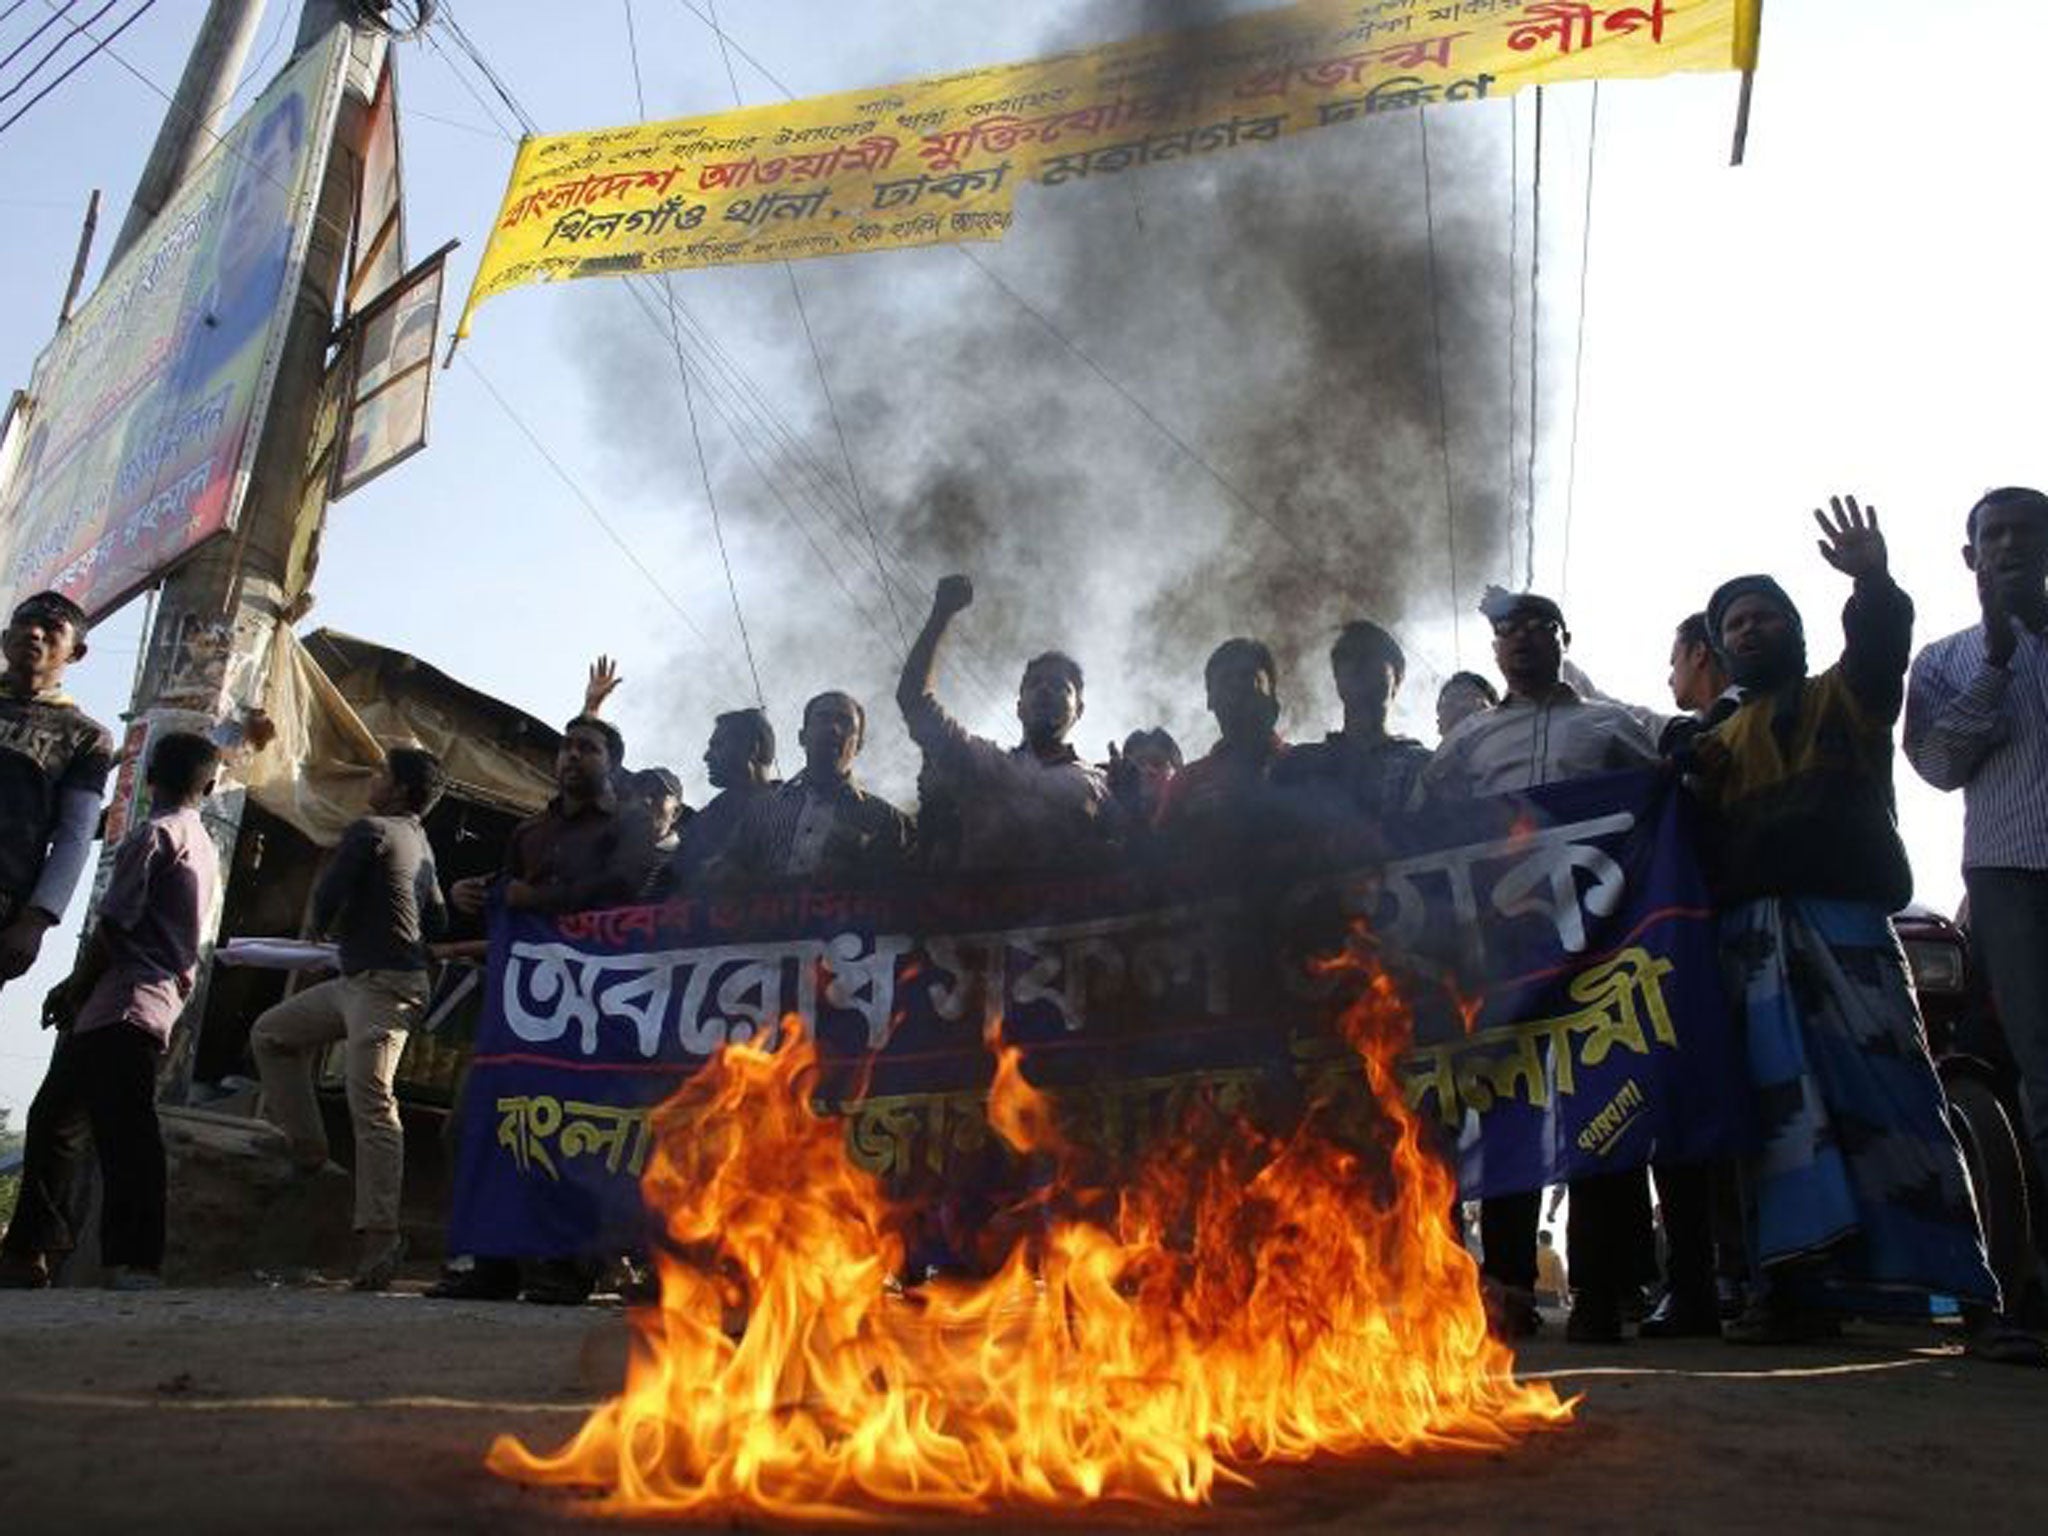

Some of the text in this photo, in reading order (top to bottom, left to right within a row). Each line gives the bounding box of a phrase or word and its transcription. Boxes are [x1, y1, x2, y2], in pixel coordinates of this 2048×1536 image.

[501, 164, 684, 231] বাংলাদেশ
[699, 135, 900, 191] আওয়ামী
[543, 193, 708, 249] খিলগাঁও
[872, 158, 1014, 210] ঢাকা
[503, 931, 911, 1057] অবরোধ
